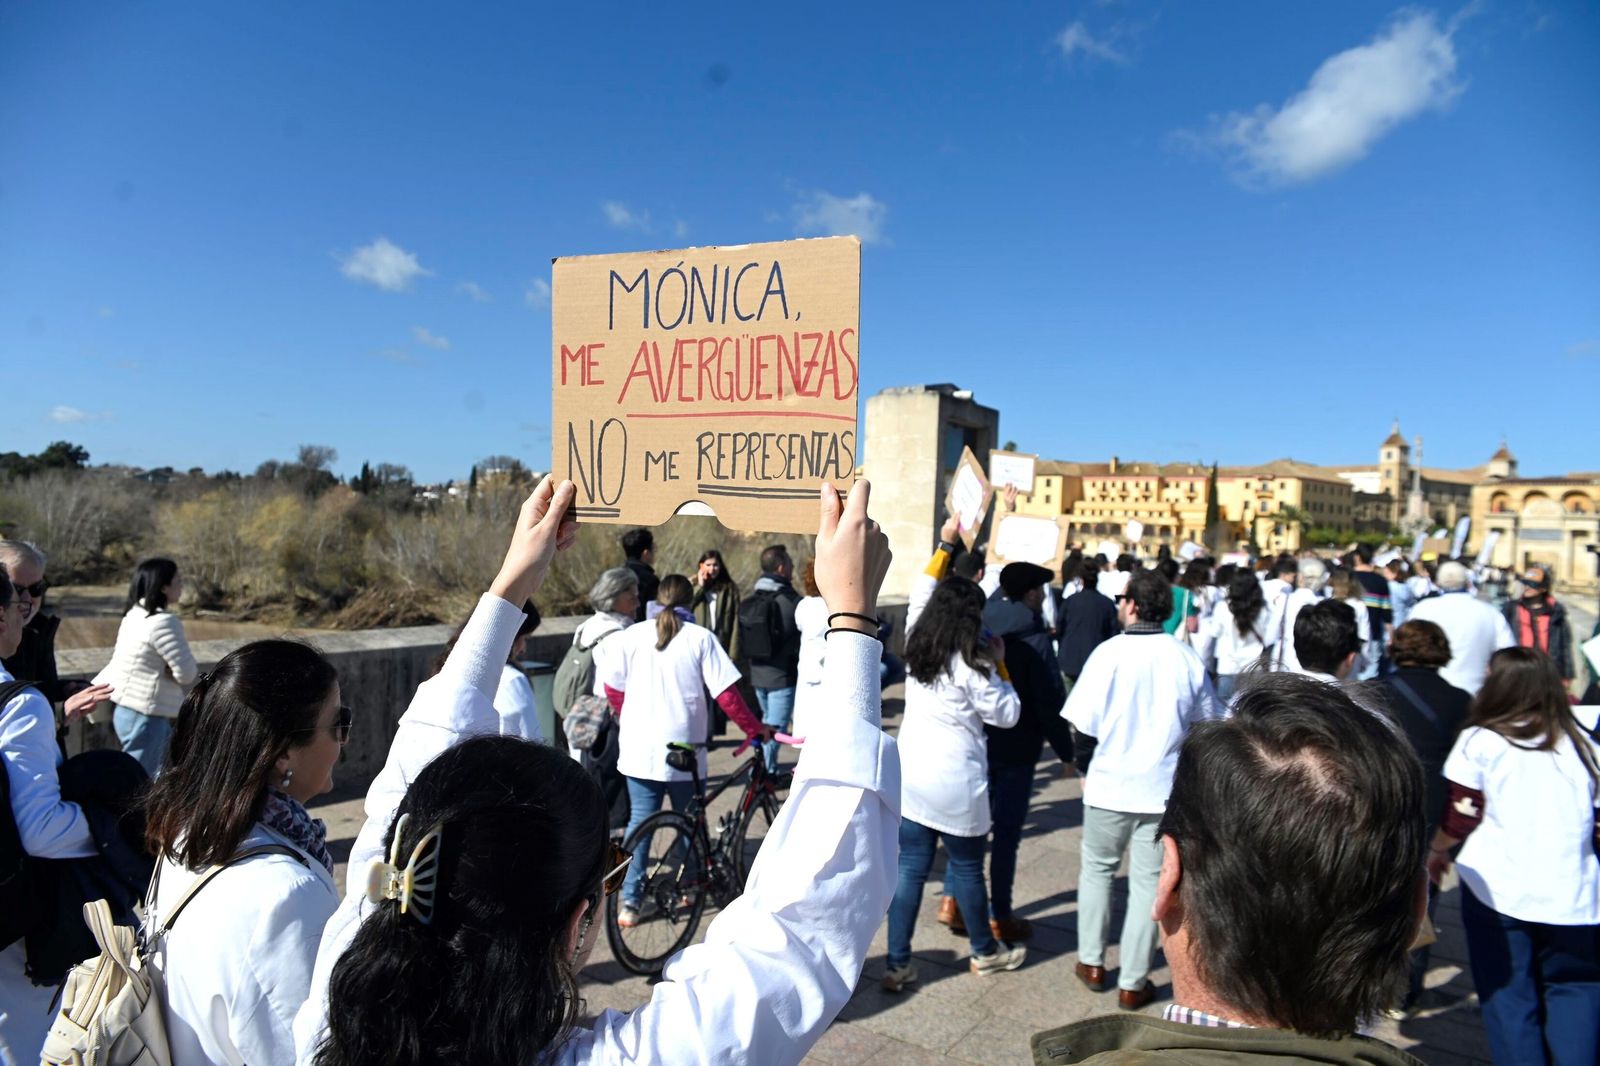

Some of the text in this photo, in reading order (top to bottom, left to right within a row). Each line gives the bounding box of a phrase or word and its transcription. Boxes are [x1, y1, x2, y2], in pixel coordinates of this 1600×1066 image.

[609, 260, 801, 330] MÓNICA,
[560, 328, 858, 405] ME AVERGÜENZAS
[568, 418, 855, 506] NO ME REPRESENTAS
